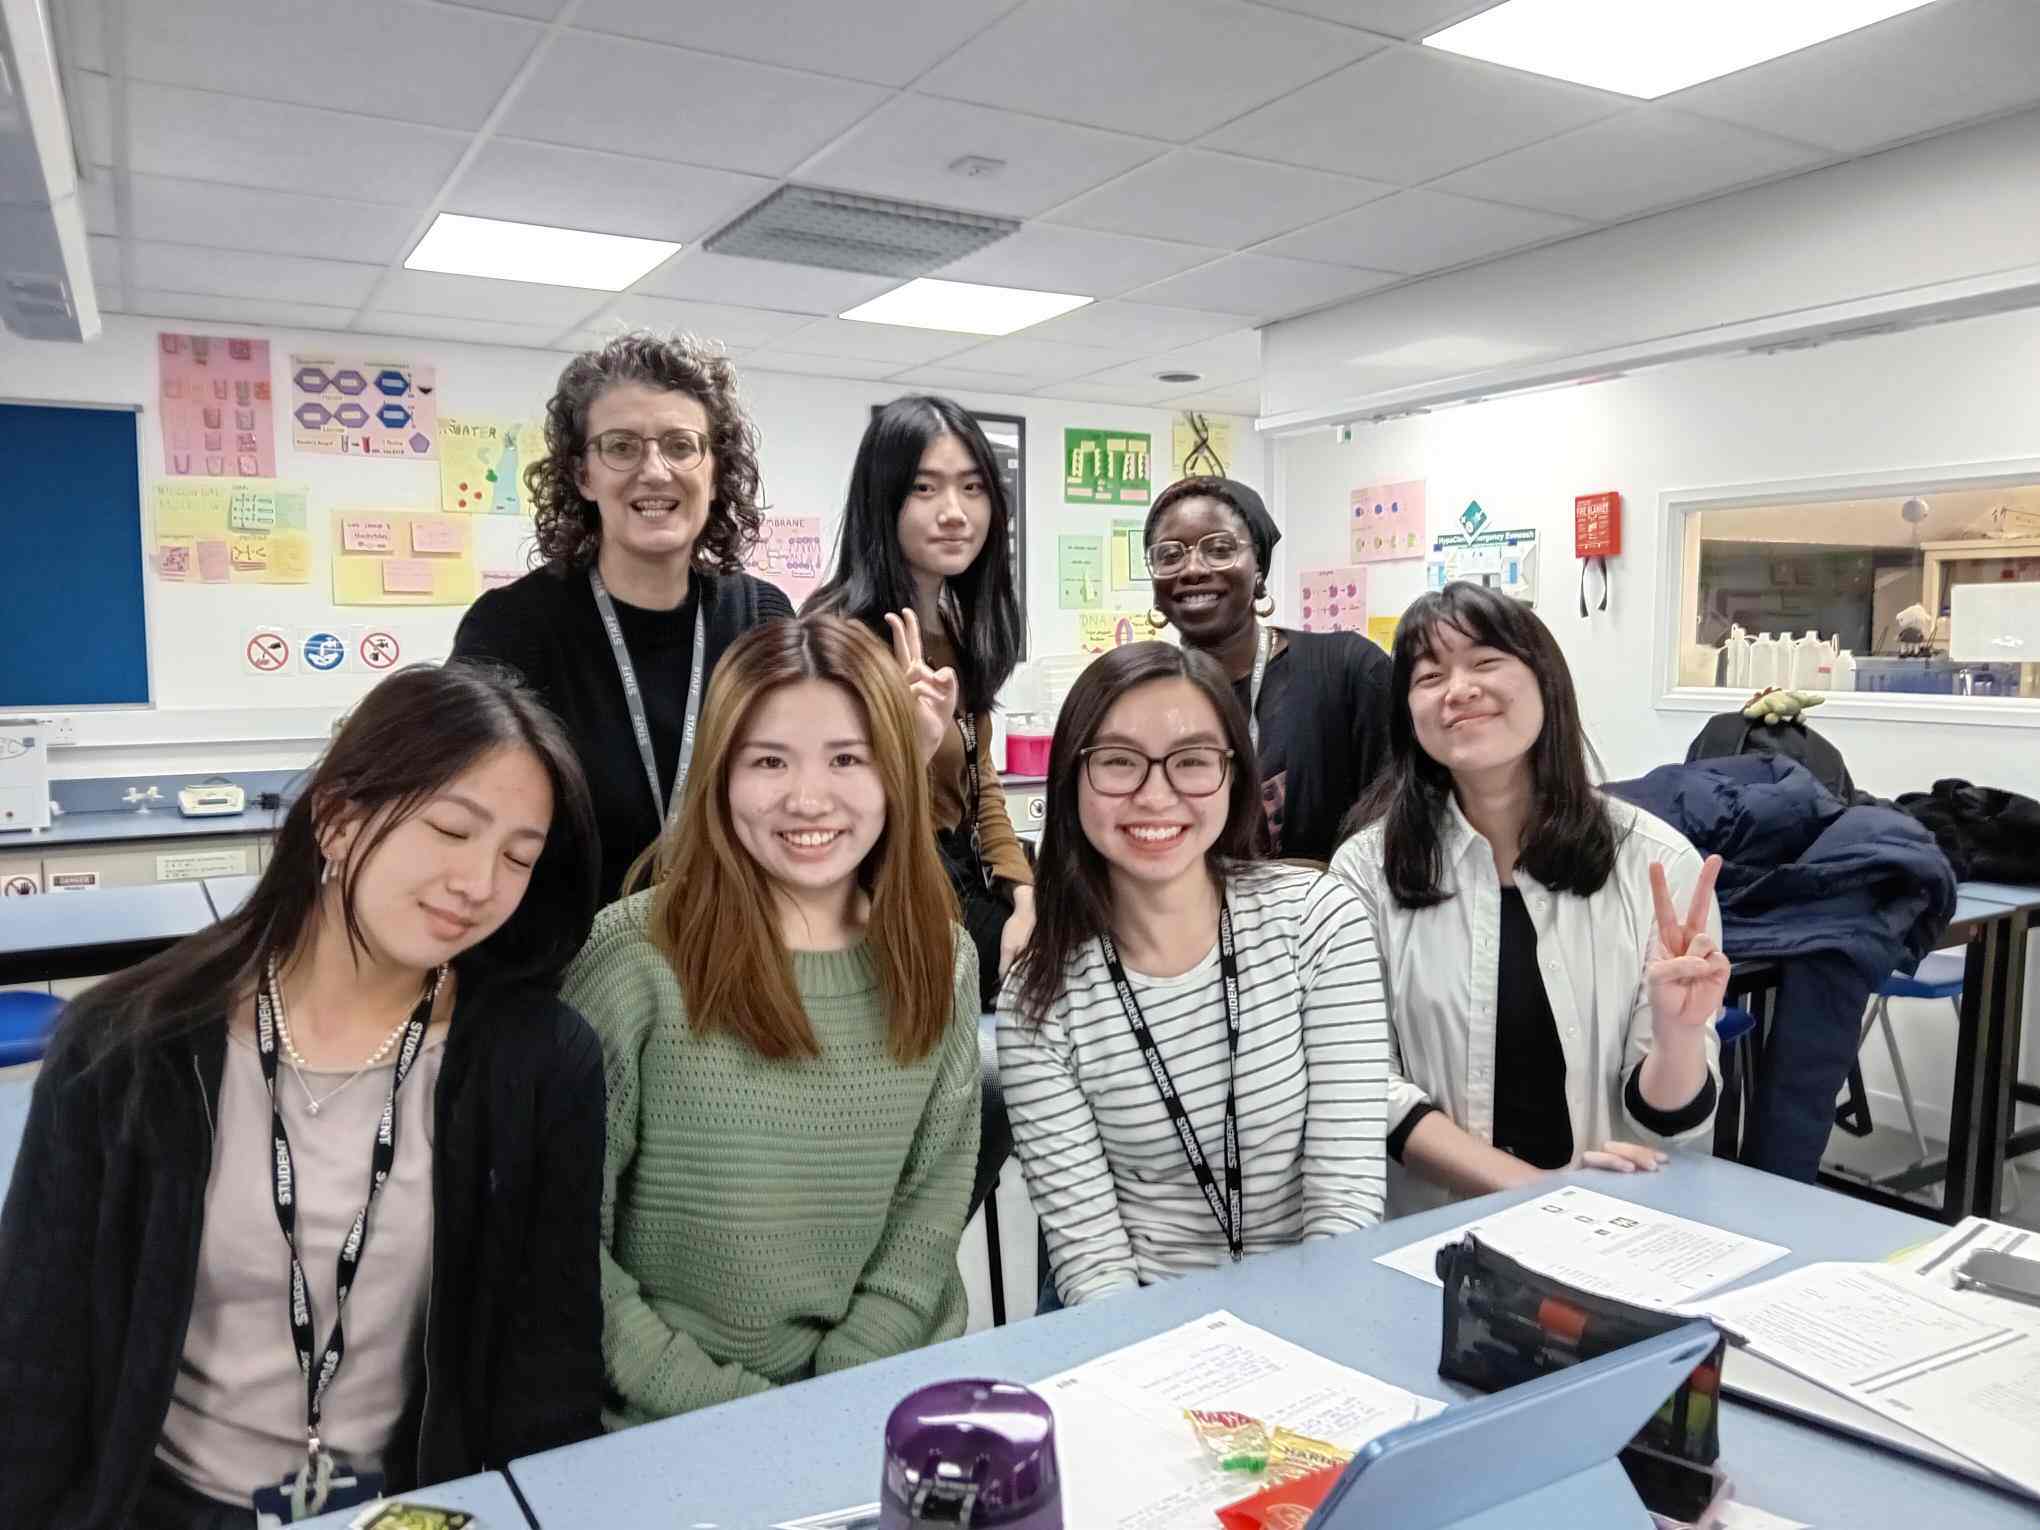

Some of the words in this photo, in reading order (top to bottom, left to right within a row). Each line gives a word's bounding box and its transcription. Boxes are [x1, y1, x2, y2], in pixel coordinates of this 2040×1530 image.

[258, 992, 274, 1054] STUDENT
[1116, 981, 1145, 1031] STUDENT
[1225, 975, 1240, 1031] STUDENT
[1146, 1047, 1175, 1100] STUDENT
[1176, 1116, 1202, 1167] STUDENT
[275, 1136, 292, 1206] STUDENT
